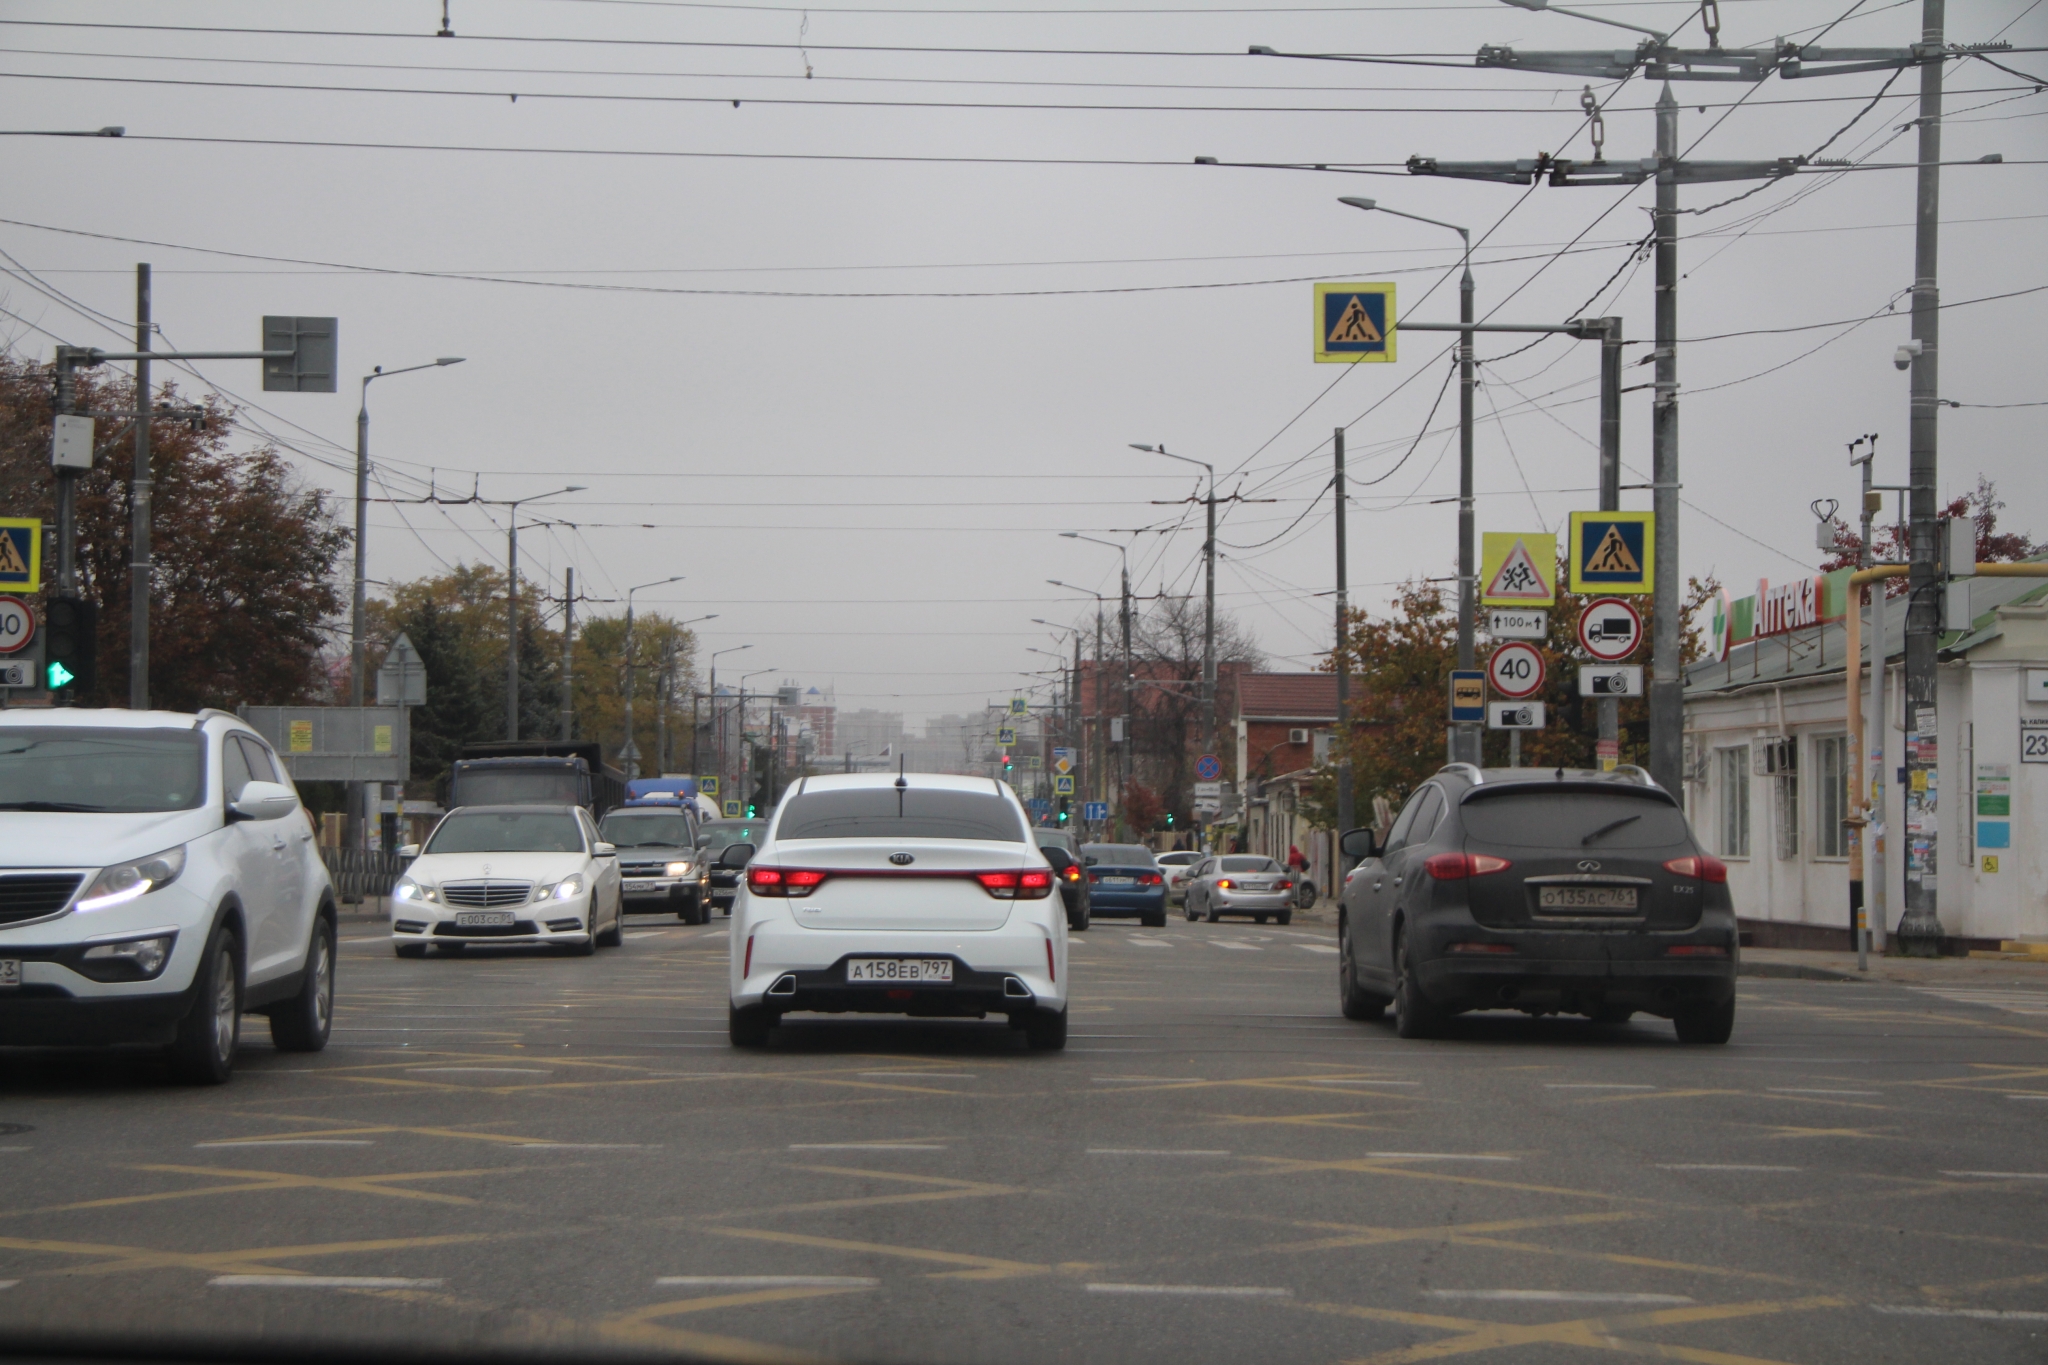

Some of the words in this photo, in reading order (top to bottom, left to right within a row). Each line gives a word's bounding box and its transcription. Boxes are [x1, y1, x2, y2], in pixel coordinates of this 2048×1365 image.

[1751, 577, 1817, 637] Аптека
[1503, 616, 1524, 627] 100
[1500, 658, 1531, 680] 40
[892, 854, 911, 863] KIA
[0, 961, 15, 977] 3
[923, 961, 949, 975] 797
